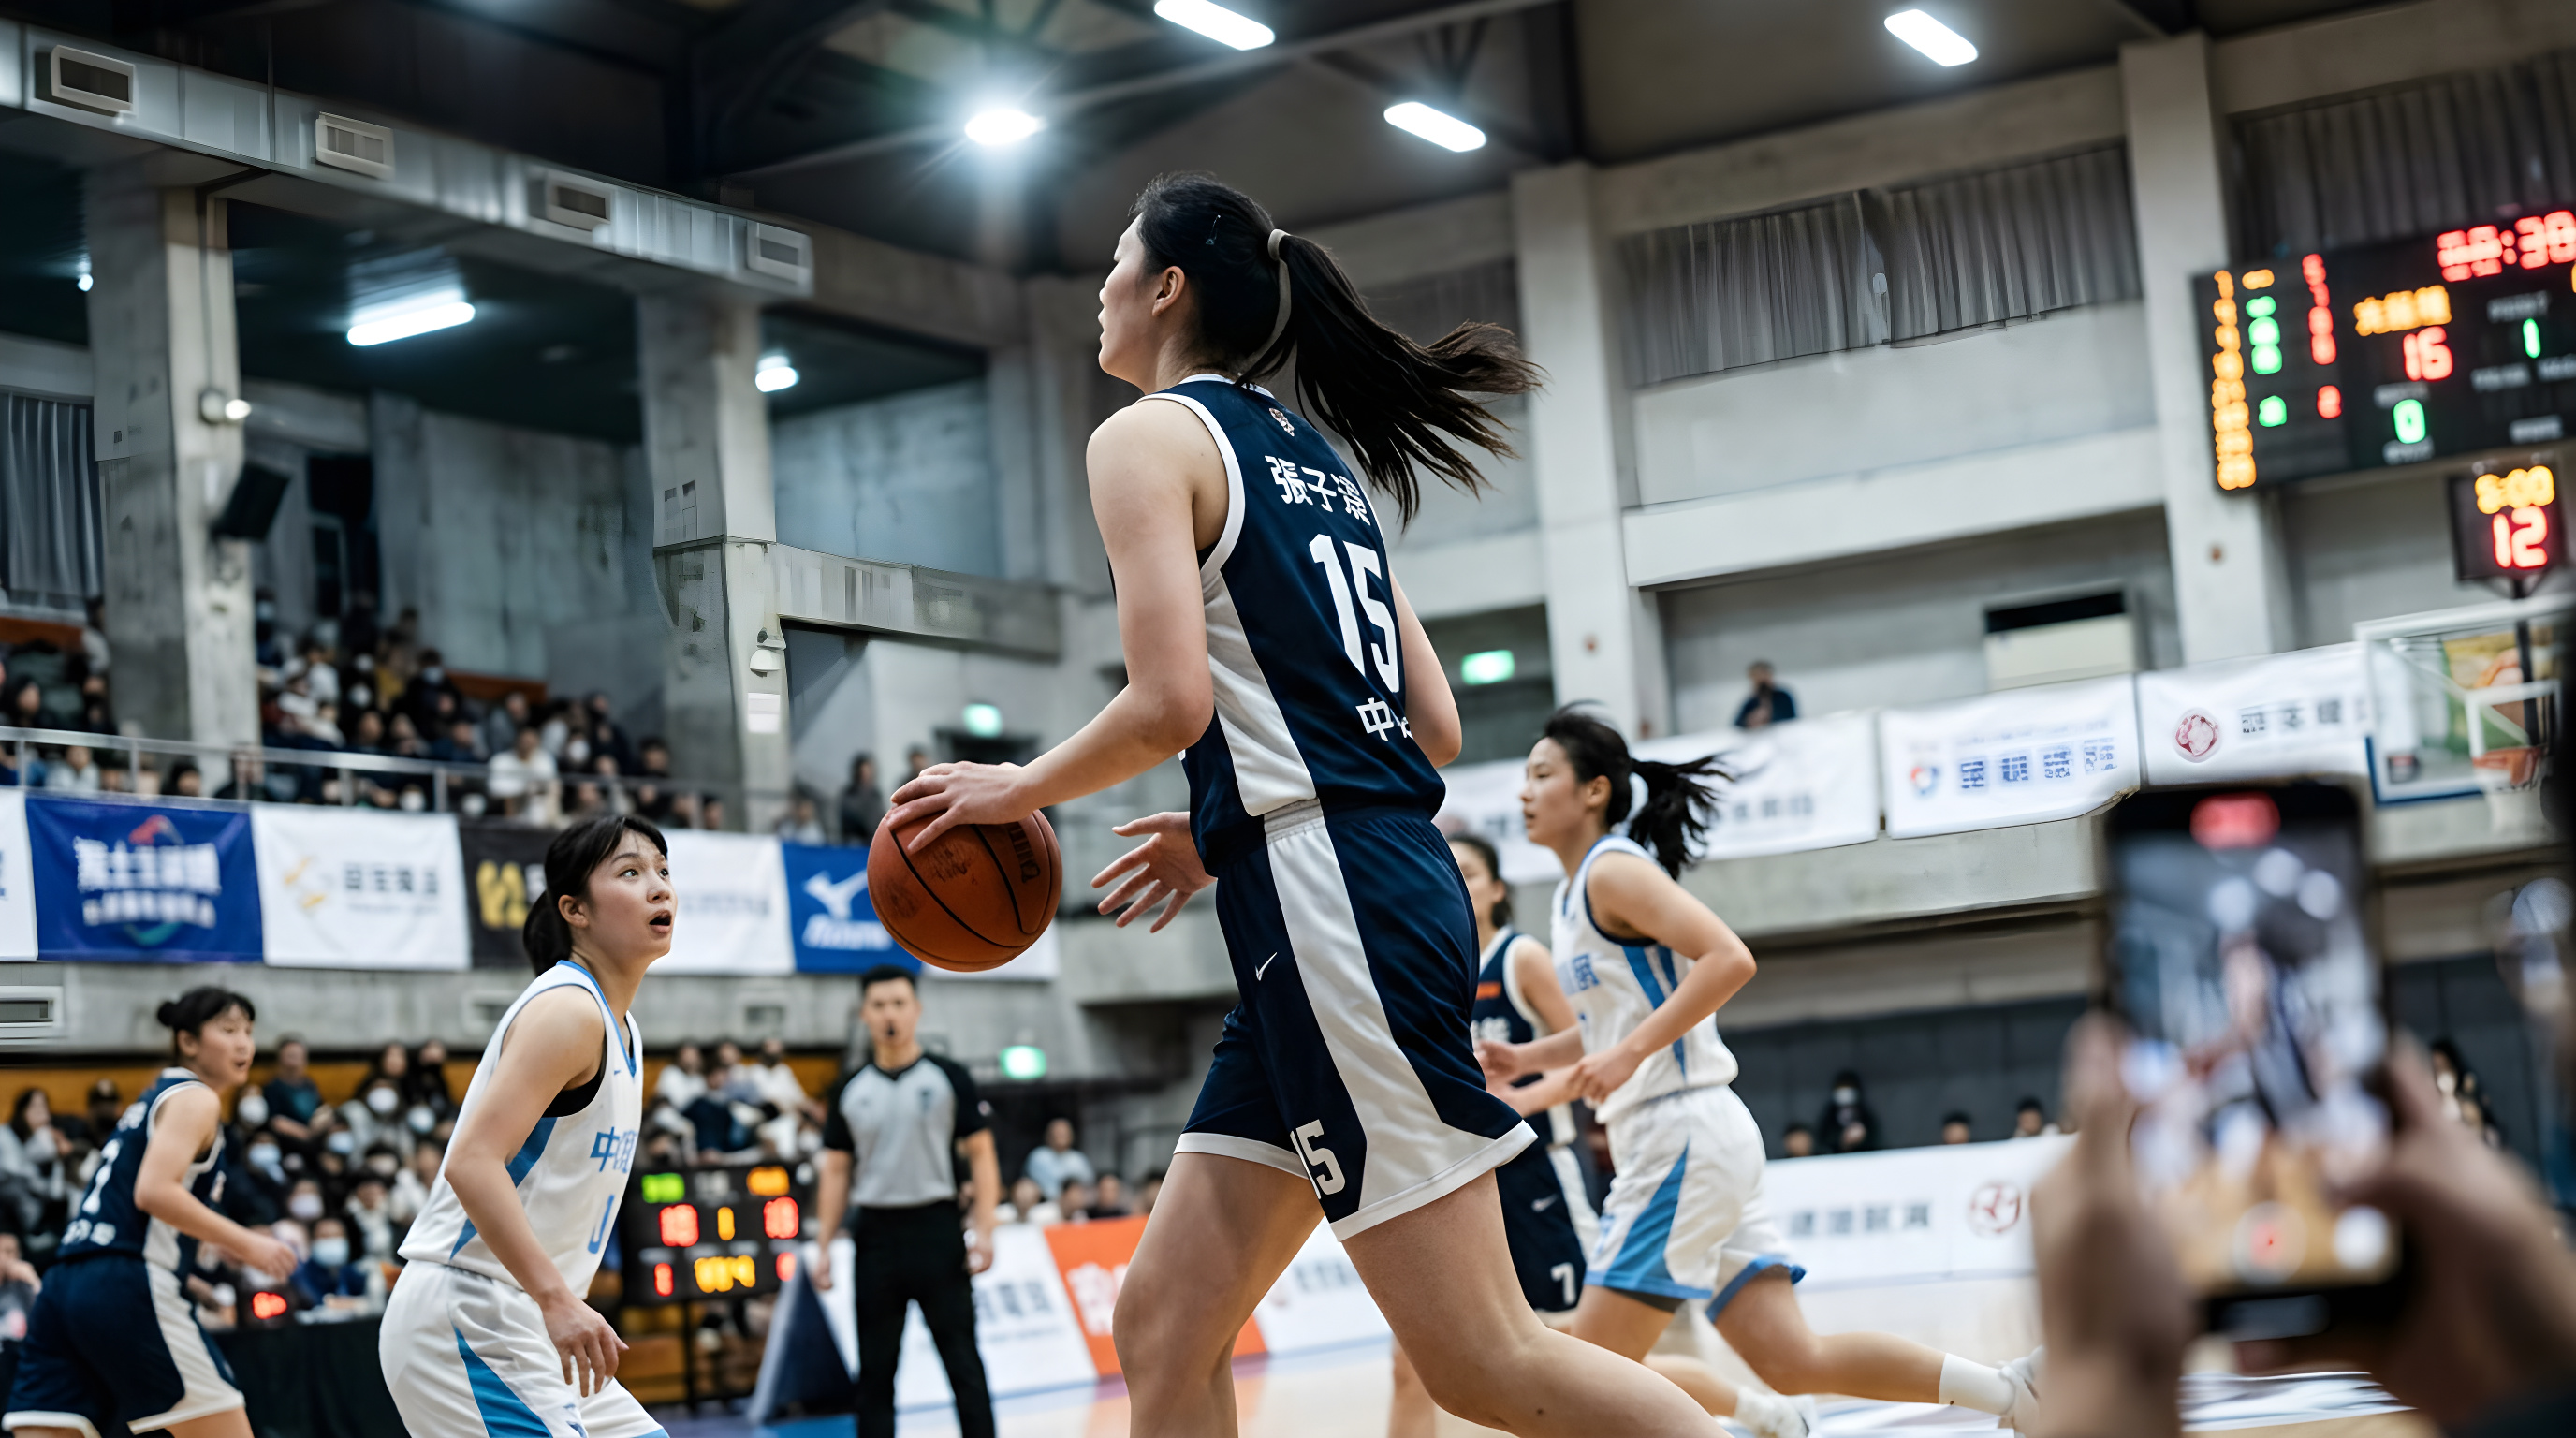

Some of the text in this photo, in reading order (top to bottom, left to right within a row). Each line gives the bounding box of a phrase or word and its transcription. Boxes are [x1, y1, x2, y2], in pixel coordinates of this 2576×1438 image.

[2492, 505, 2548, 569] 12
[1309, 533, 1399, 693] 15
[1289, 1119, 1346, 1200] 15
